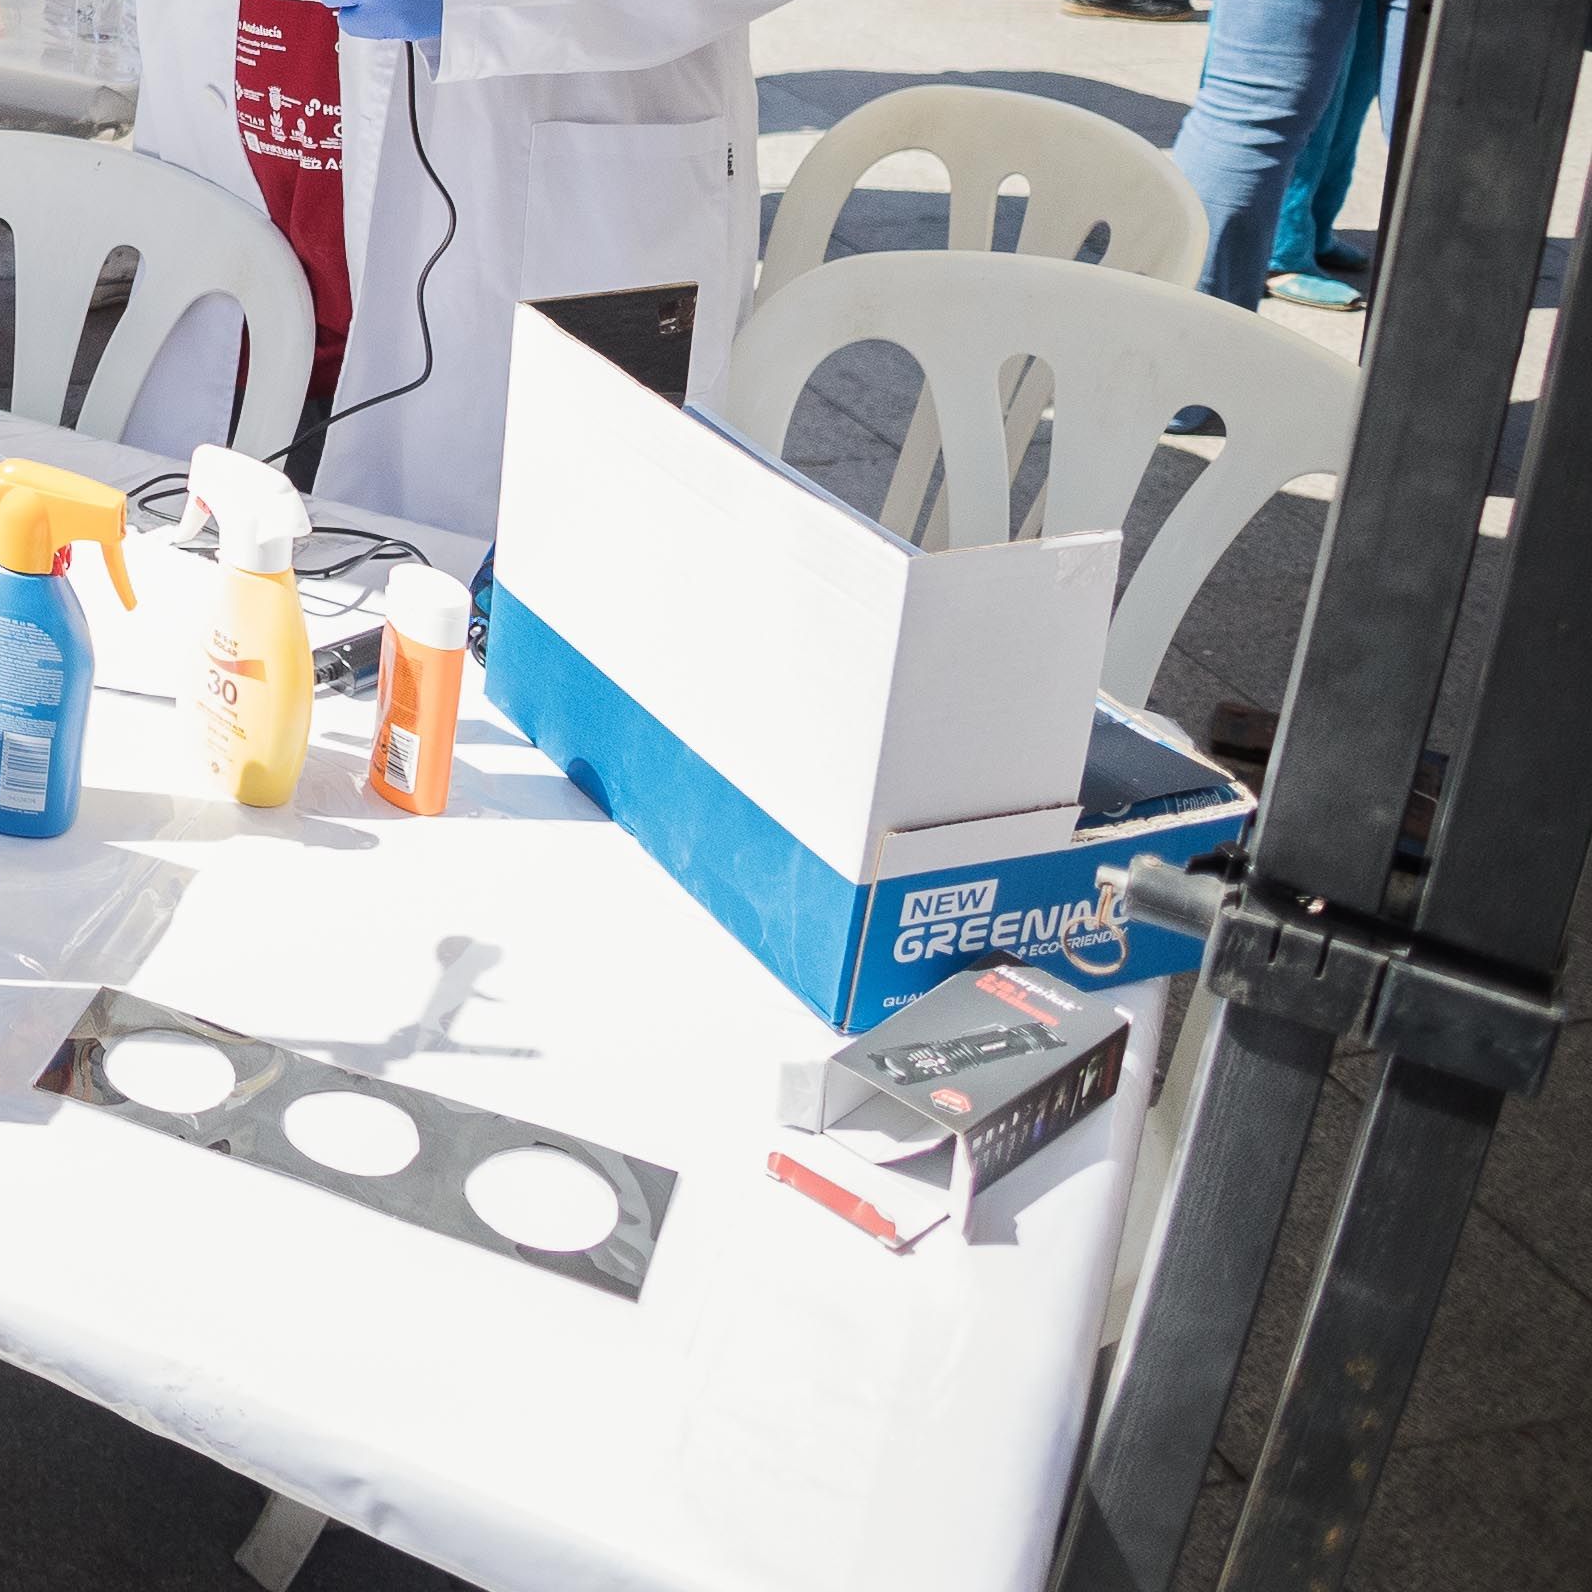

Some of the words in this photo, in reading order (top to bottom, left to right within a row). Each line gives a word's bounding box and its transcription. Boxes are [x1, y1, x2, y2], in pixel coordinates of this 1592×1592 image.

[208, 669, 237, 705] 30
[1176, 788, 1224, 813] Ecolabel
[910, 886, 990, 922] NEW
